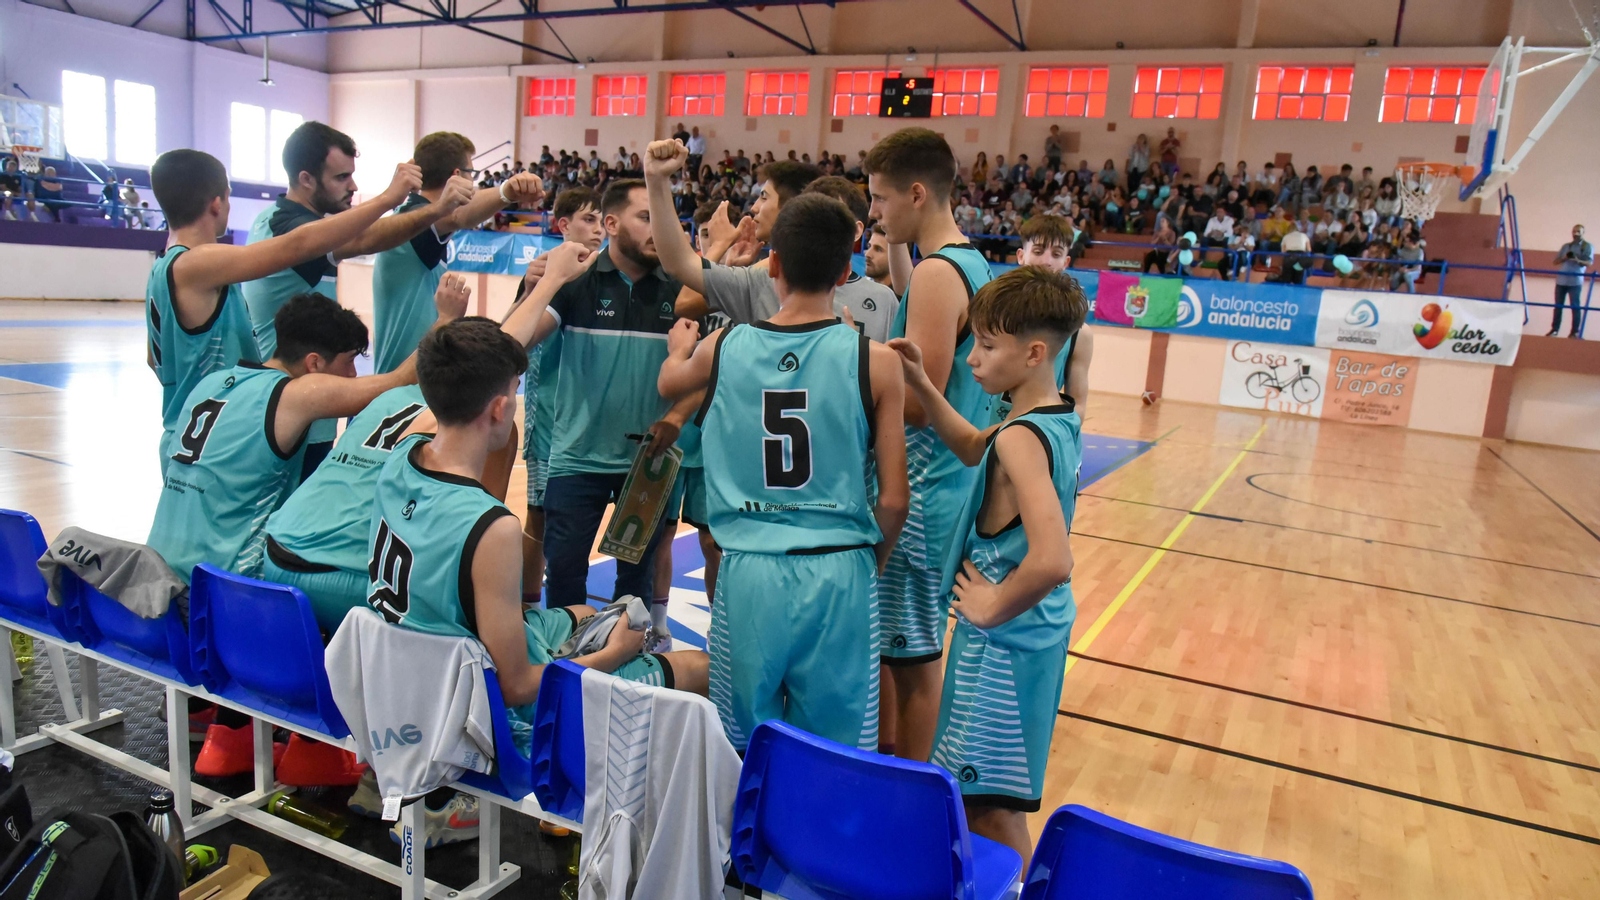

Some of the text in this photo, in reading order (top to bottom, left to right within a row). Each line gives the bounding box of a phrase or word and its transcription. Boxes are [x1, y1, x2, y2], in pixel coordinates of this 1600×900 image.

[596, 309, 615, 317] vive
[1210, 293, 1299, 316] baloncesto
[1231, 341, 1287, 366] Casa
[1452, 339, 1501, 355] cesto
[1336, 356, 1408, 378] Bar de
[1335, 374, 1404, 397] Tapas
[170, 397, 229, 465] 9
[762, 388, 813, 489] 5
[59, 539, 102, 572] vive
